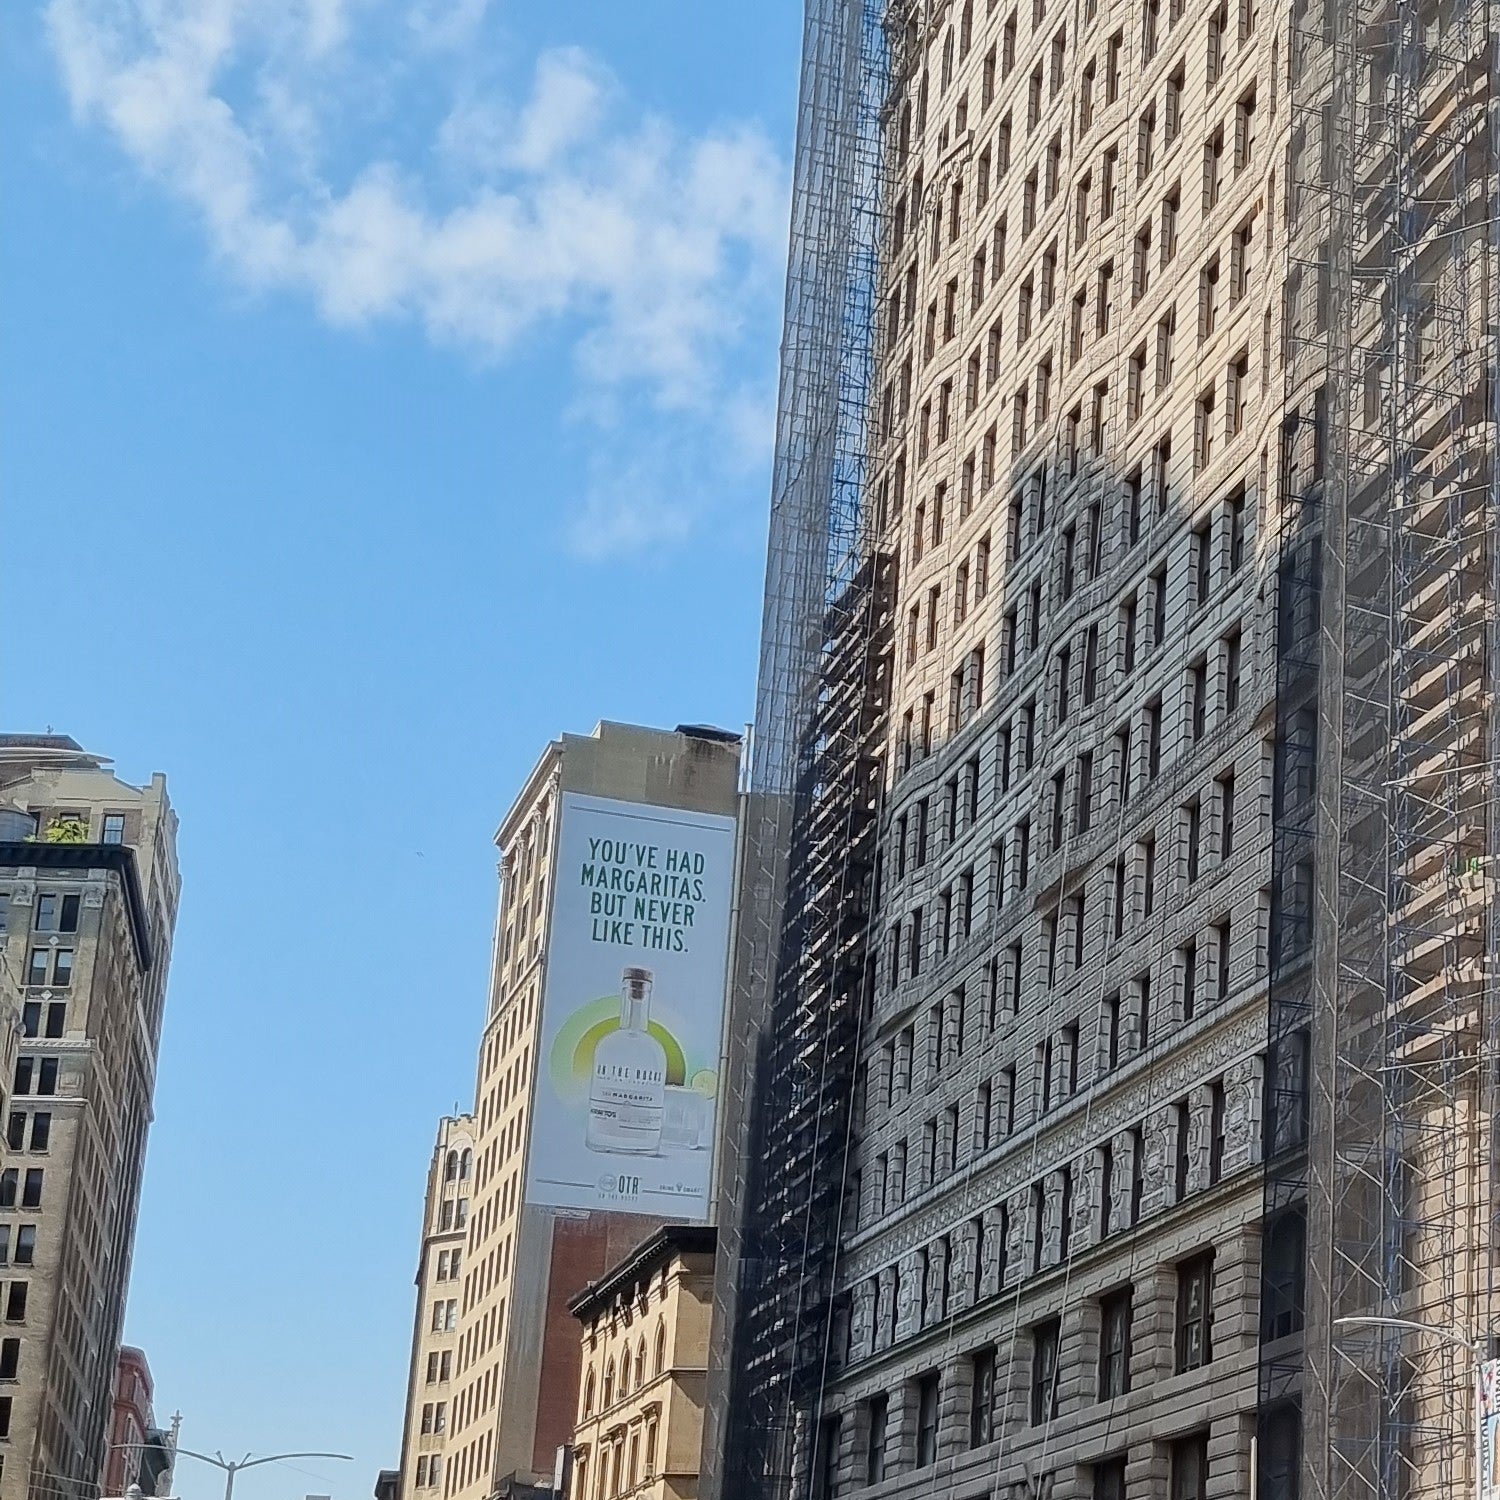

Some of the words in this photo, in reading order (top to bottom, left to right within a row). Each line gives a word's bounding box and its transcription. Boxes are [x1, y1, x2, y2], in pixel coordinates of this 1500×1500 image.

[589, 837, 658, 869] YOU'VE
[665, 849, 705, 875] HAD
[581, 863, 706, 902] MARGARITAS.
[590, 891, 626, 917] BUT
[633, 897, 695, 927] NEVER
[592, 918, 634, 945] LIKE
[642, 924, 689, 952] THIS.
[618, 1175, 639, 1194] OTR
